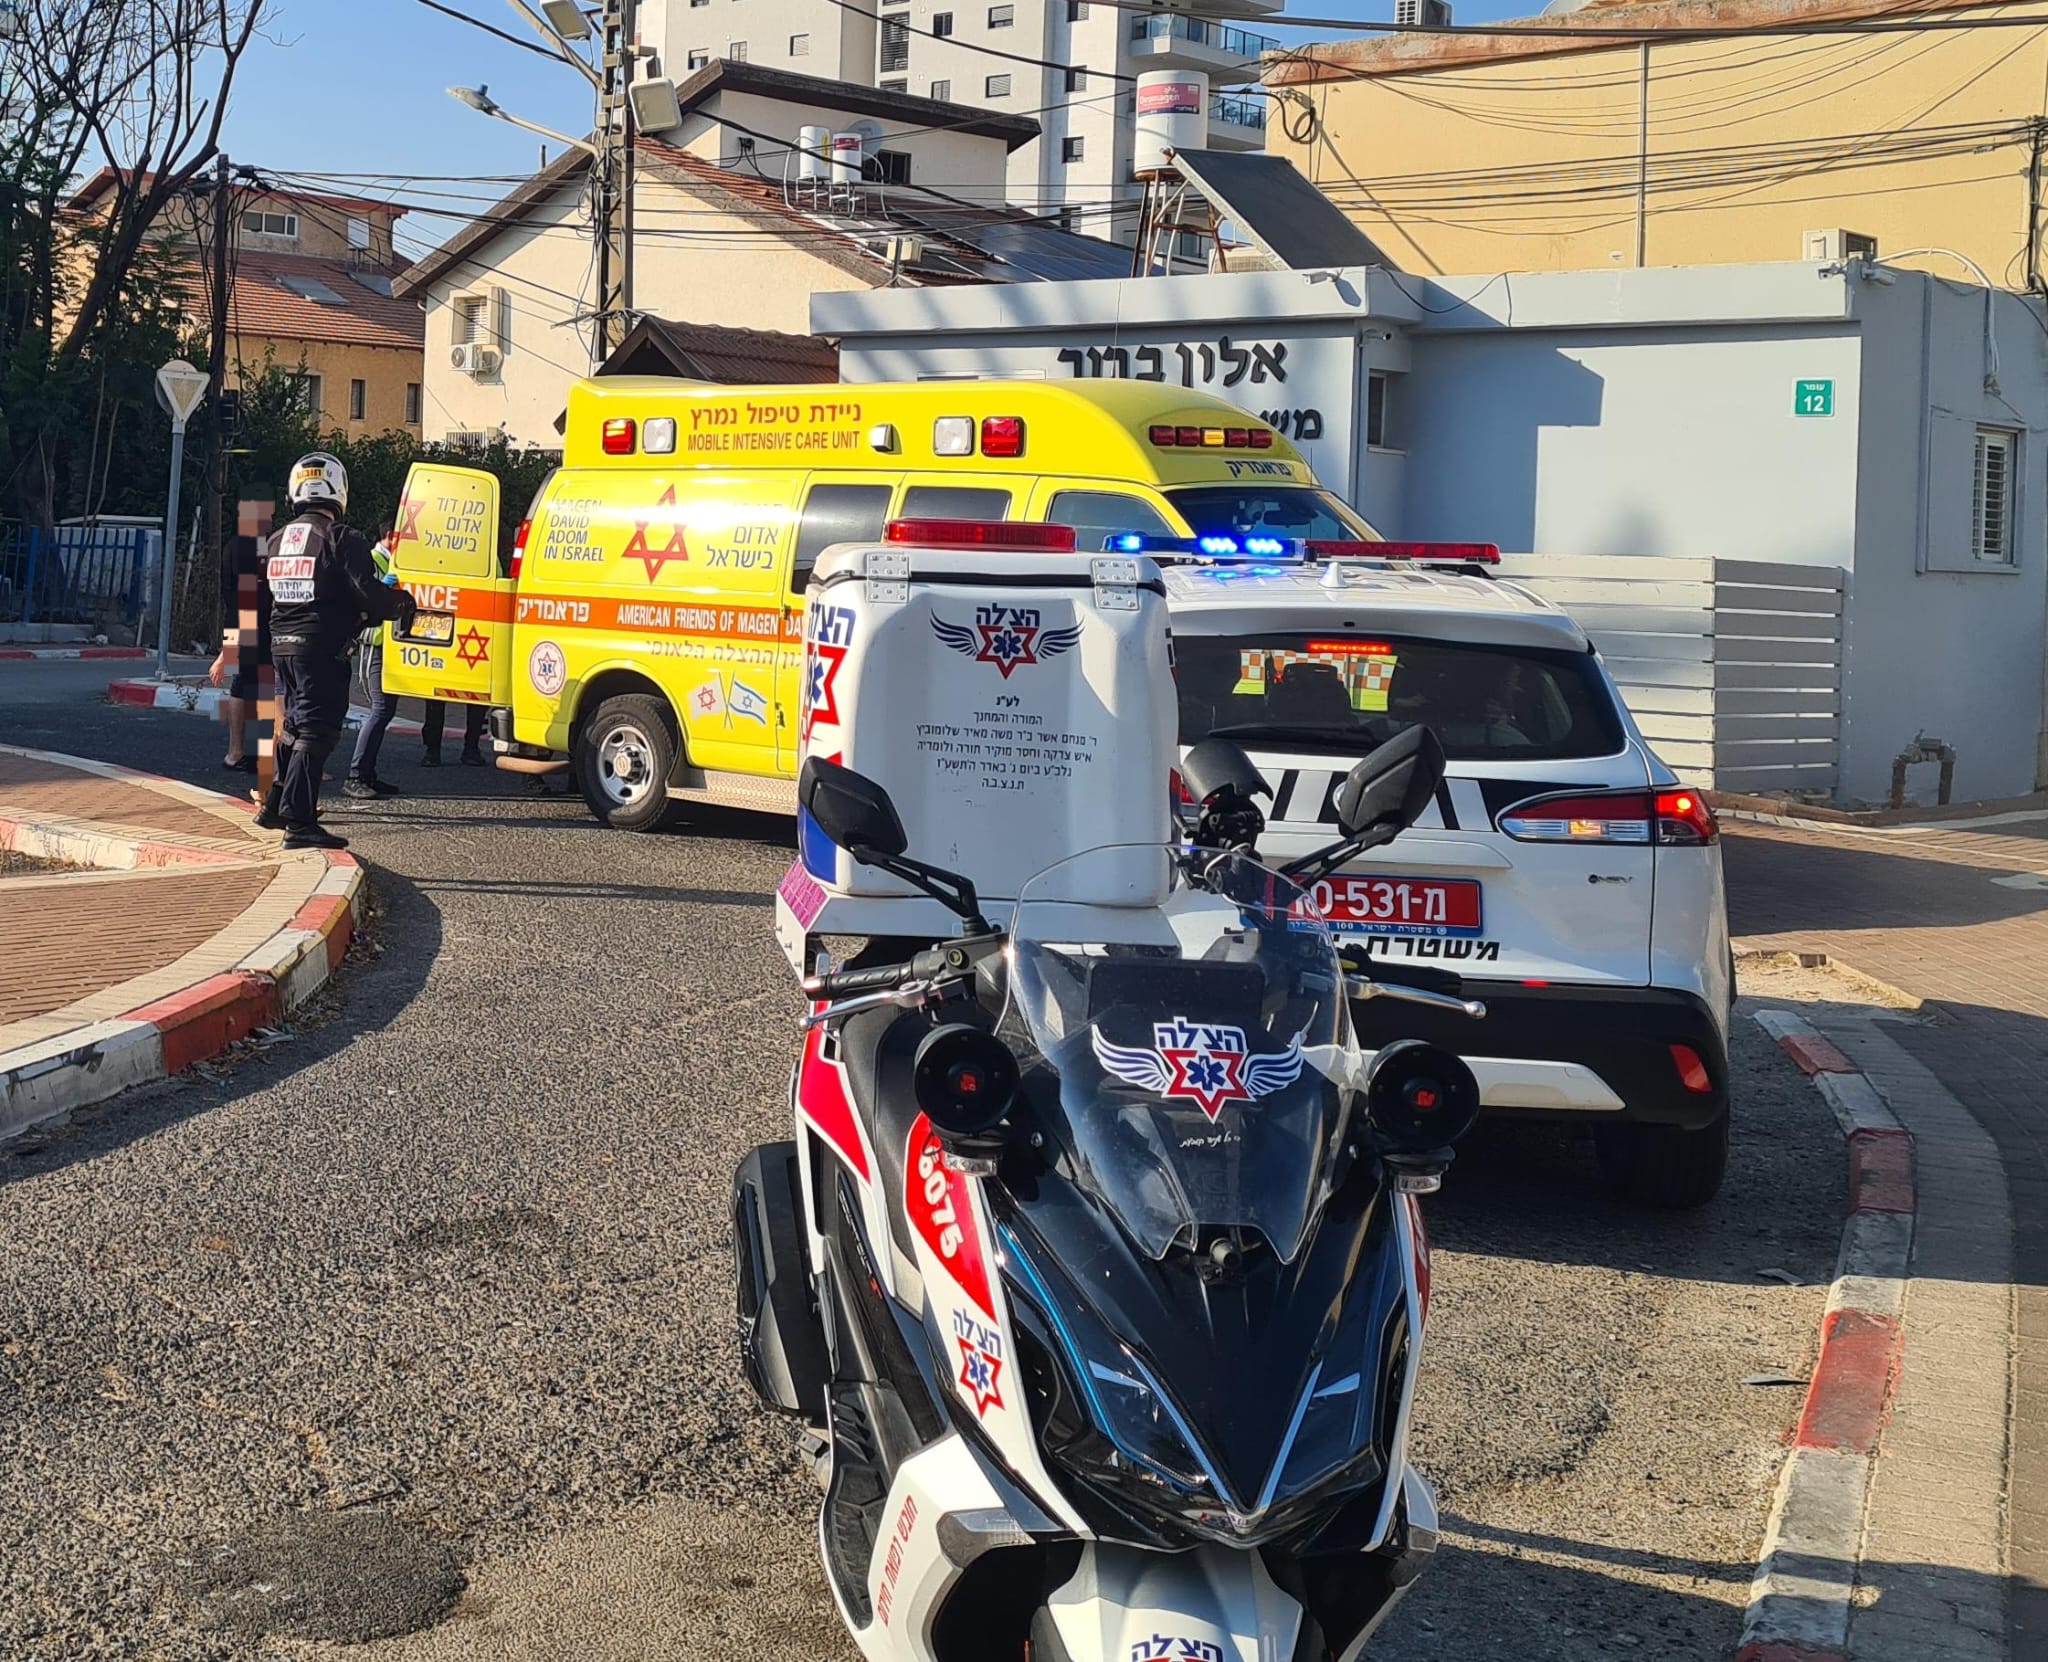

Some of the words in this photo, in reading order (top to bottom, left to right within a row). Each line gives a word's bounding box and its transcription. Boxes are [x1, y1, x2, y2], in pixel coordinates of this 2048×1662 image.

[1175, 336, 1287, 388] אלון
[1804, 395, 1824, 412] 12
[690, 407, 738, 431] נמרץ
[747, 402, 800, 424] טיפול
[809, 404, 862, 423] ניידת
[688, 433, 729, 451] MOBILE
[733, 432, 792, 450] INTENSIVE
[796, 431, 828, 449] CARE
[832, 430, 860, 449] UNIT
[1224, 461, 1292, 478] פראמדיק
[437, 497, 458, 512] דוד
[462, 501, 486, 516] מגן
[446, 516, 482, 534] אדום
[550, 514, 590, 528] DAVID
[425, 530, 477, 552] בישראל
[547, 529, 588, 544] ADOM
[733, 526, 779, 545] אדום
[544, 545, 558, 559] IN
[562, 546, 604, 561] ISRAEL
[706, 544, 774, 569] בישראל
[270, 560, 313, 576] חובש
[517, 599, 590, 623] פראמדיק
[976, 602, 1040, 627] הצלה
[616, 605, 671, 628] AMERICAN
[674, 607, 717, 631] FRIENDS
[719, 610, 733, 632] OF
[736, 611, 779, 635] MAGEN
[400, 647, 430, 668] 101
[712, 644, 773, 665] ההצלה
[974, 711, 1009, 724] והמחנך
[1012, 713, 1042, 726] המורה
[916, 724, 960, 737] שלומוביץ
[963, 727, 987, 739] מאיר
[990, 728, 1013, 740] משה
[1037, 731, 1058, 743] אשר
[1061, 733, 1086, 745] מנחם
[956, 743, 980, 755] תורה
[984, 745, 1012, 759] מוקיר
[1016, 747, 1040, 759] וחסד
[1043, 749, 1071, 763] צדקה
[1074, 752, 1092, 763] איש
[980, 760, 1006, 773] באדר
[1020, 764, 1040, 775] ביום
[1336, 922, 1353, 931] 100
[1361, 923, 1392, 932] ישראל
[1398, 926, 1432, 934] משטרת
[1368, 935, 1500, 961] משטרת
[1157, 1020, 1244, 1053] הצלה
[953, 1308, 1000, 1355] הצלה
[897, 1494, 918, 1542] חובש
[1131, 1633, 1224, 1662] הצלה
